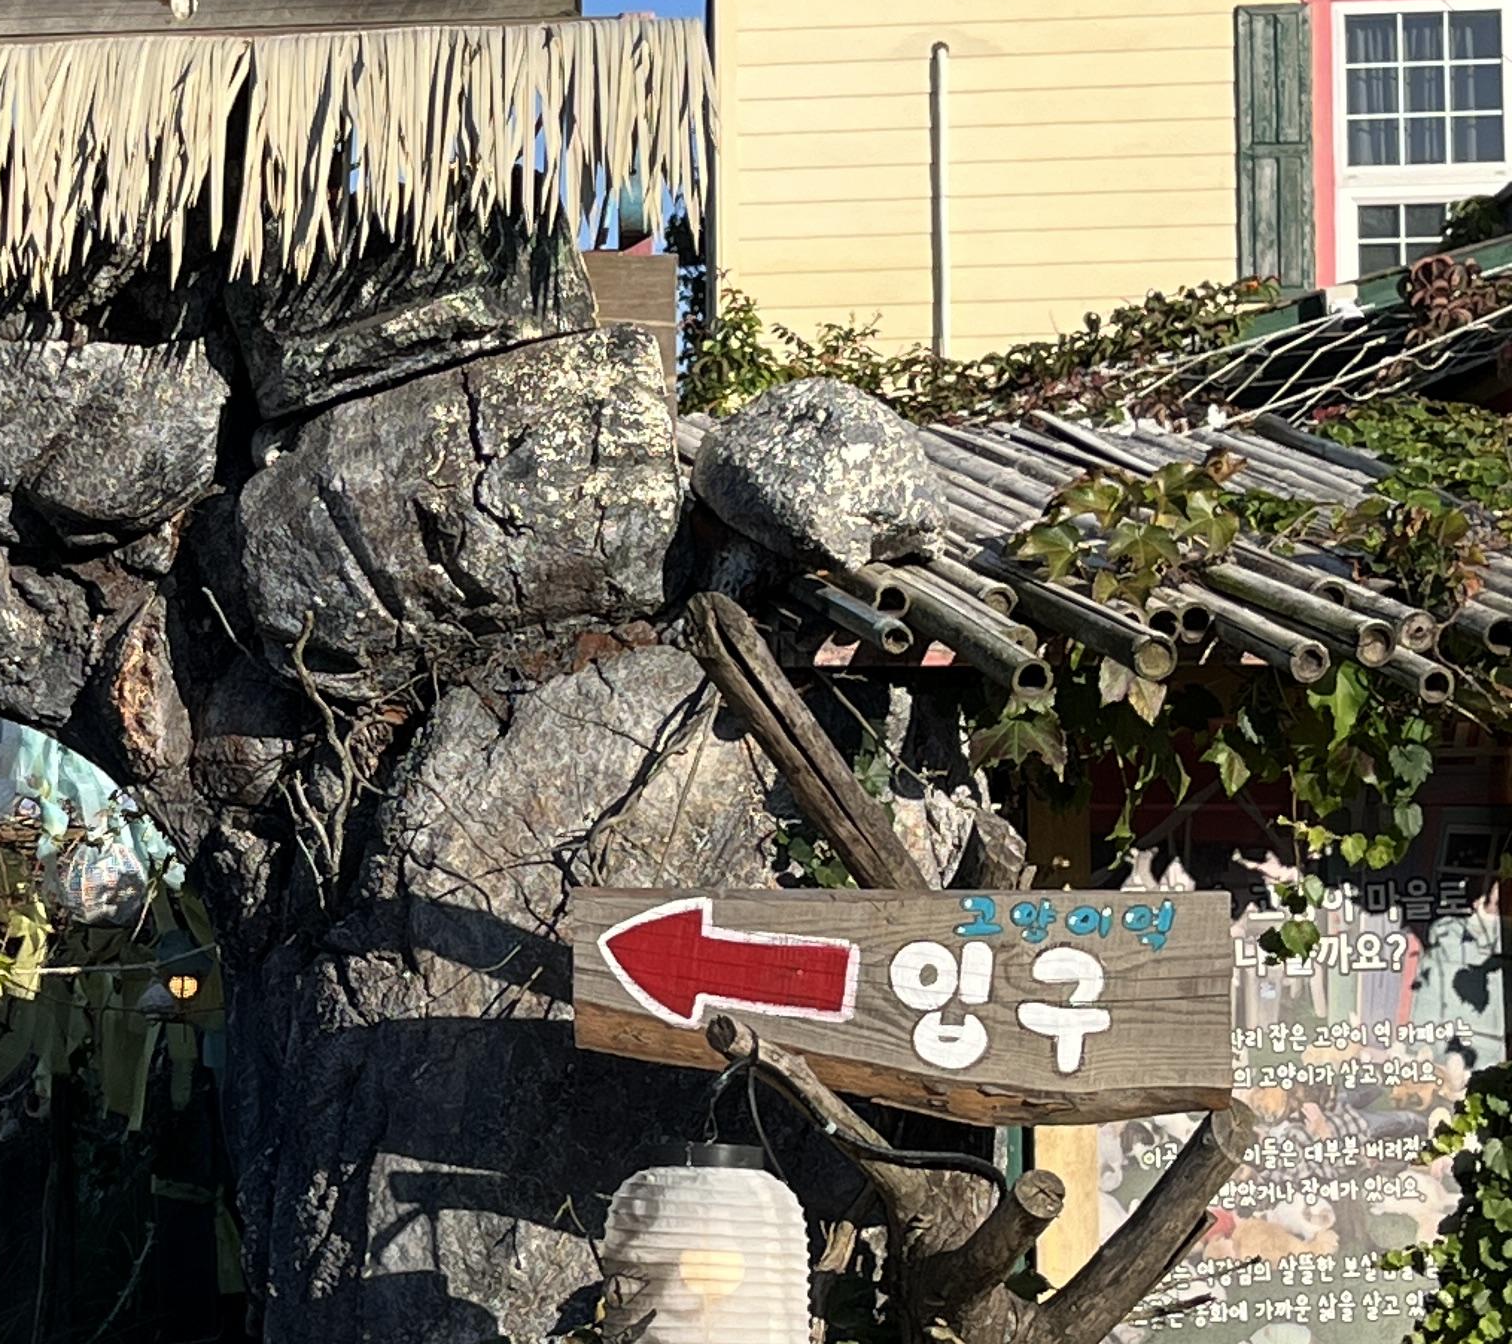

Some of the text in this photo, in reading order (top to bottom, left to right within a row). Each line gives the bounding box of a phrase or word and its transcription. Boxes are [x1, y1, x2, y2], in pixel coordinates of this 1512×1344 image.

[1367, 880, 1473, 921] 마을로
[953, 895, 1176, 951] 고양이역
[888, 940, 1112, 1073] 입구
[1268, 1022, 1308, 1052] 잡은
[1313, 1024, 1367, 1050] 고양이
[1397, 1017, 1474, 1046] 카페에는
[1259, 1061, 1335, 1089] 고양이가
[1340, 1059, 1377, 1088] 살고
[1383, 1060, 1443, 1086] 있어요.
[1304, 1136, 1359, 1165] 대부분
[1364, 1175, 1426, 1202] 있어요.
[1278, 1252, 1337, 1285] 살뜰한
[1255, 1294, 1311, 1323] 가까운
[1318, 1290, 1356, 1322] 삶을
[1362, 1290, 1401, 1321] 살고
